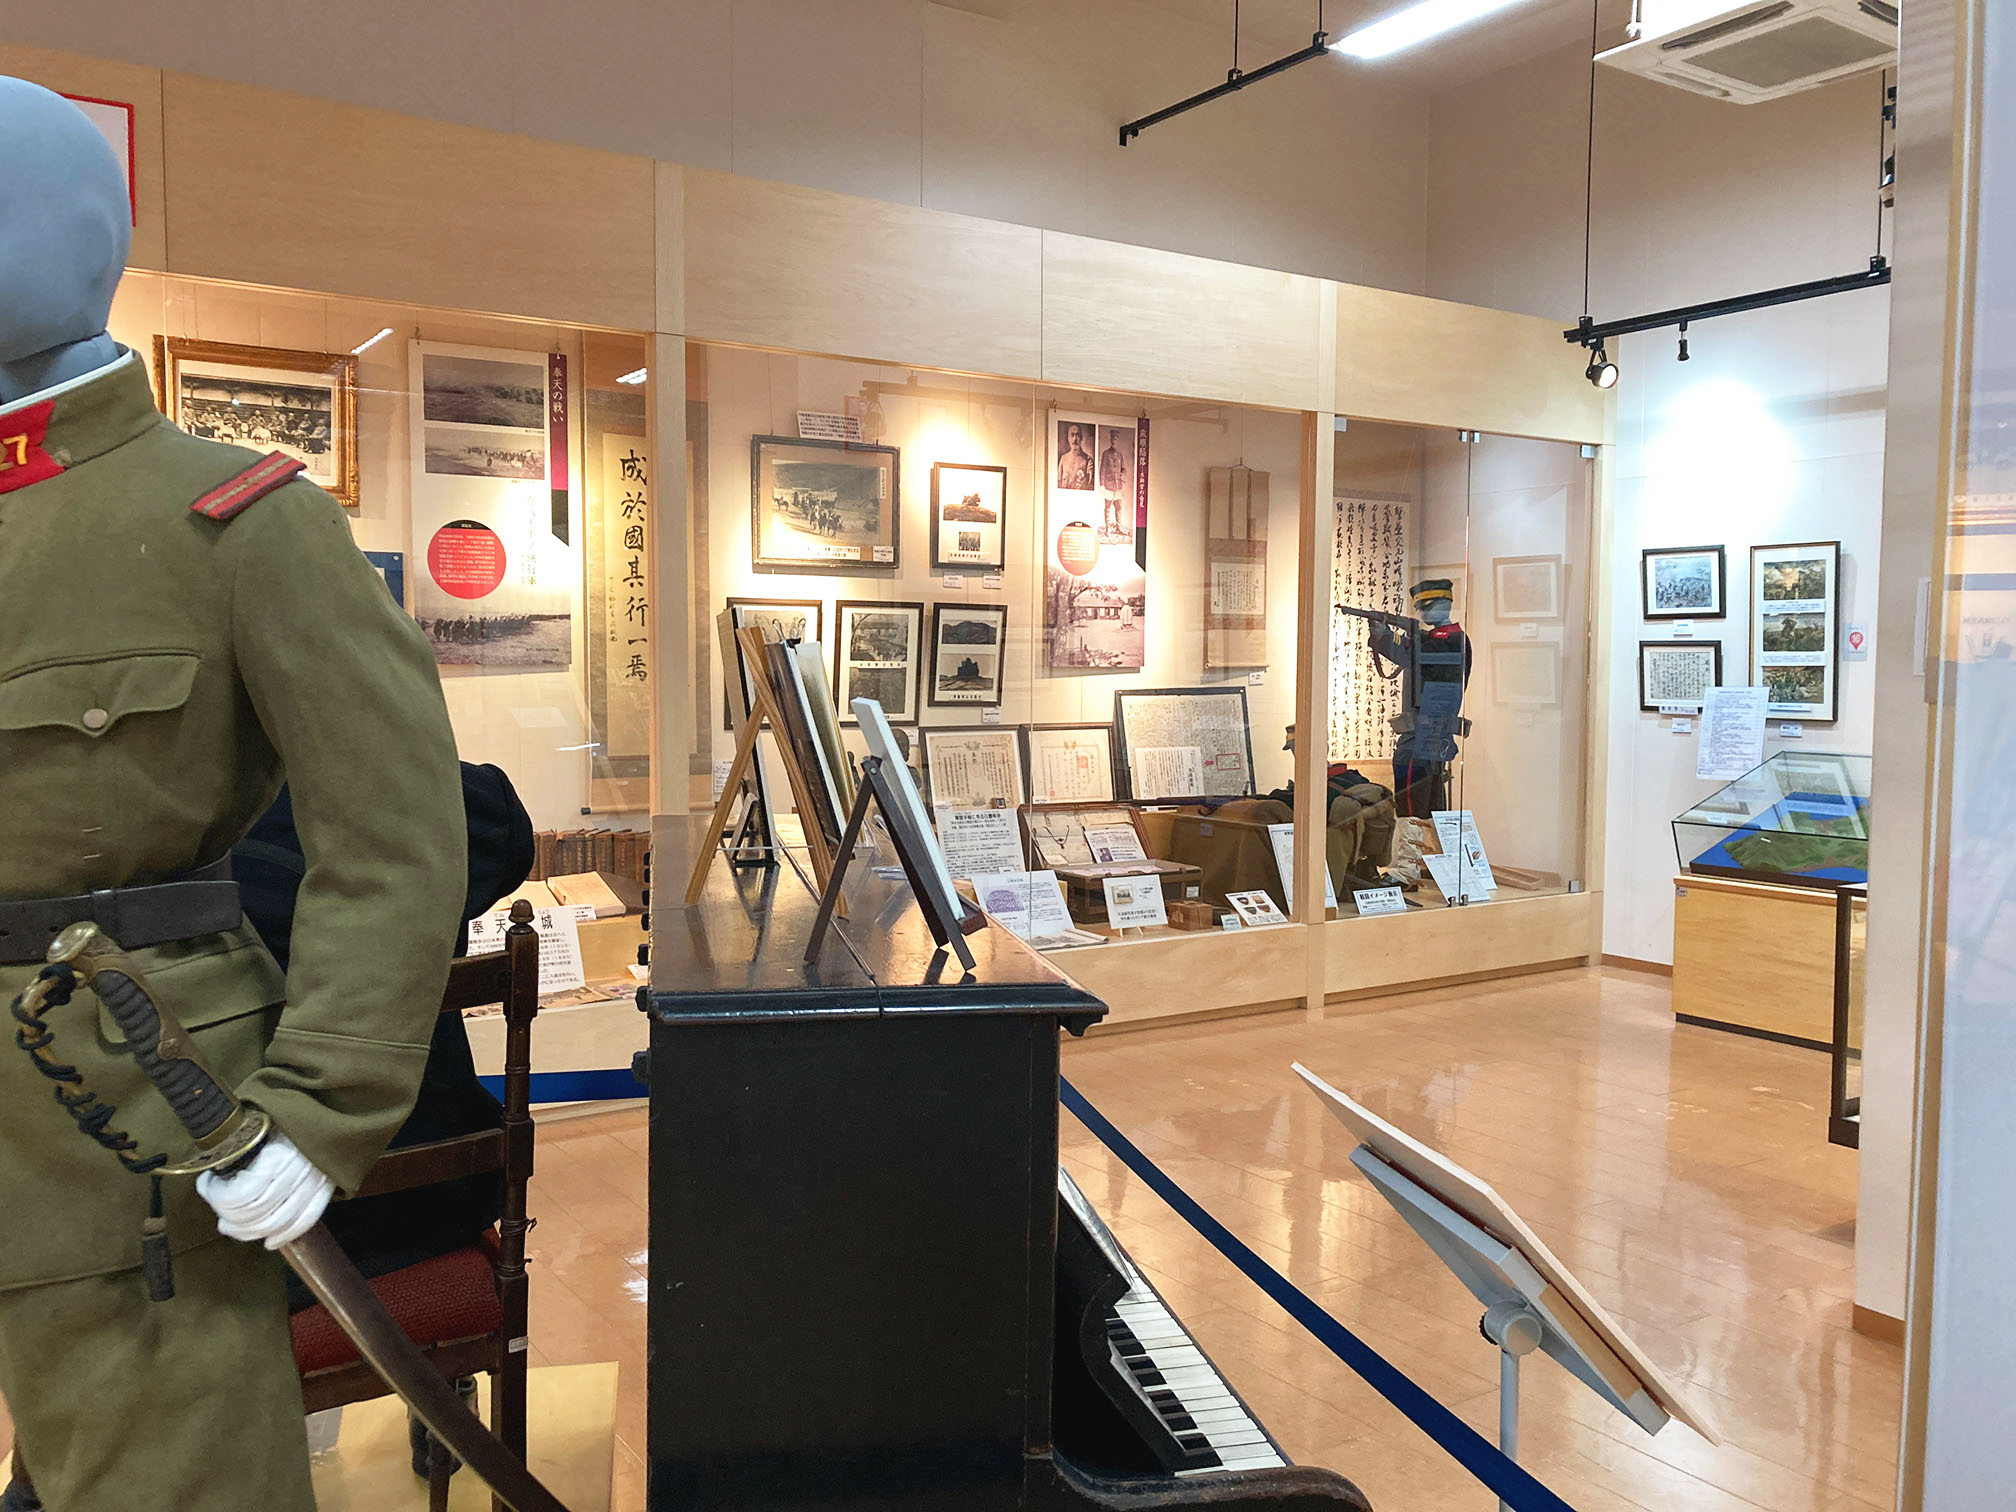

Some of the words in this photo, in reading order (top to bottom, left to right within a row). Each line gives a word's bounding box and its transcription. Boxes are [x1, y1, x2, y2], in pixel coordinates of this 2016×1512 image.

[552, 366, 564, 423] 奉天の戦い
